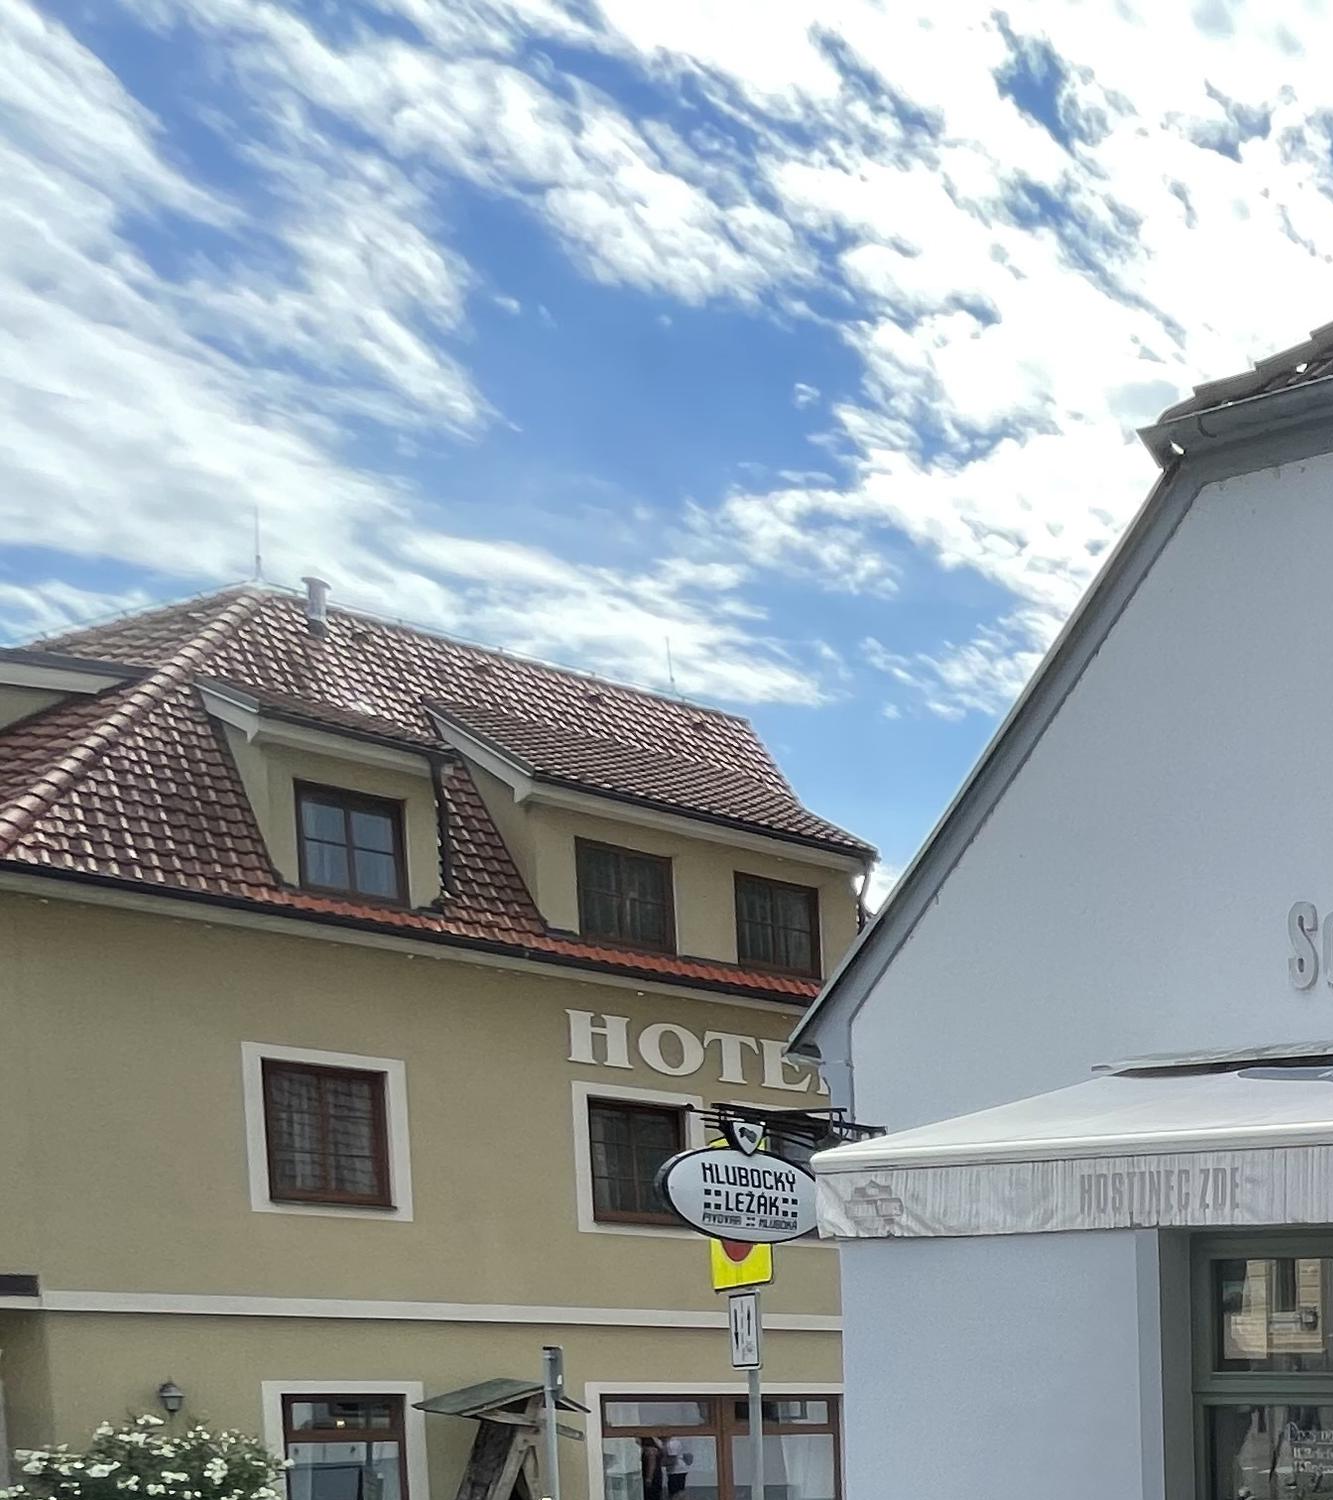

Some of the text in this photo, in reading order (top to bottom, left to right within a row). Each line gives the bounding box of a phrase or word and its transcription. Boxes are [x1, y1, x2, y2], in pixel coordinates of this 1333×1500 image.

[564, 1008, 830, 1096] HOTE
[701, 1161, 797, 1192] HLUBOCKÝ
[1080, 1167, 1239, 1217] HOSTINEC ZDE
[725, 1191, 780, 1217] LEŽÁK
